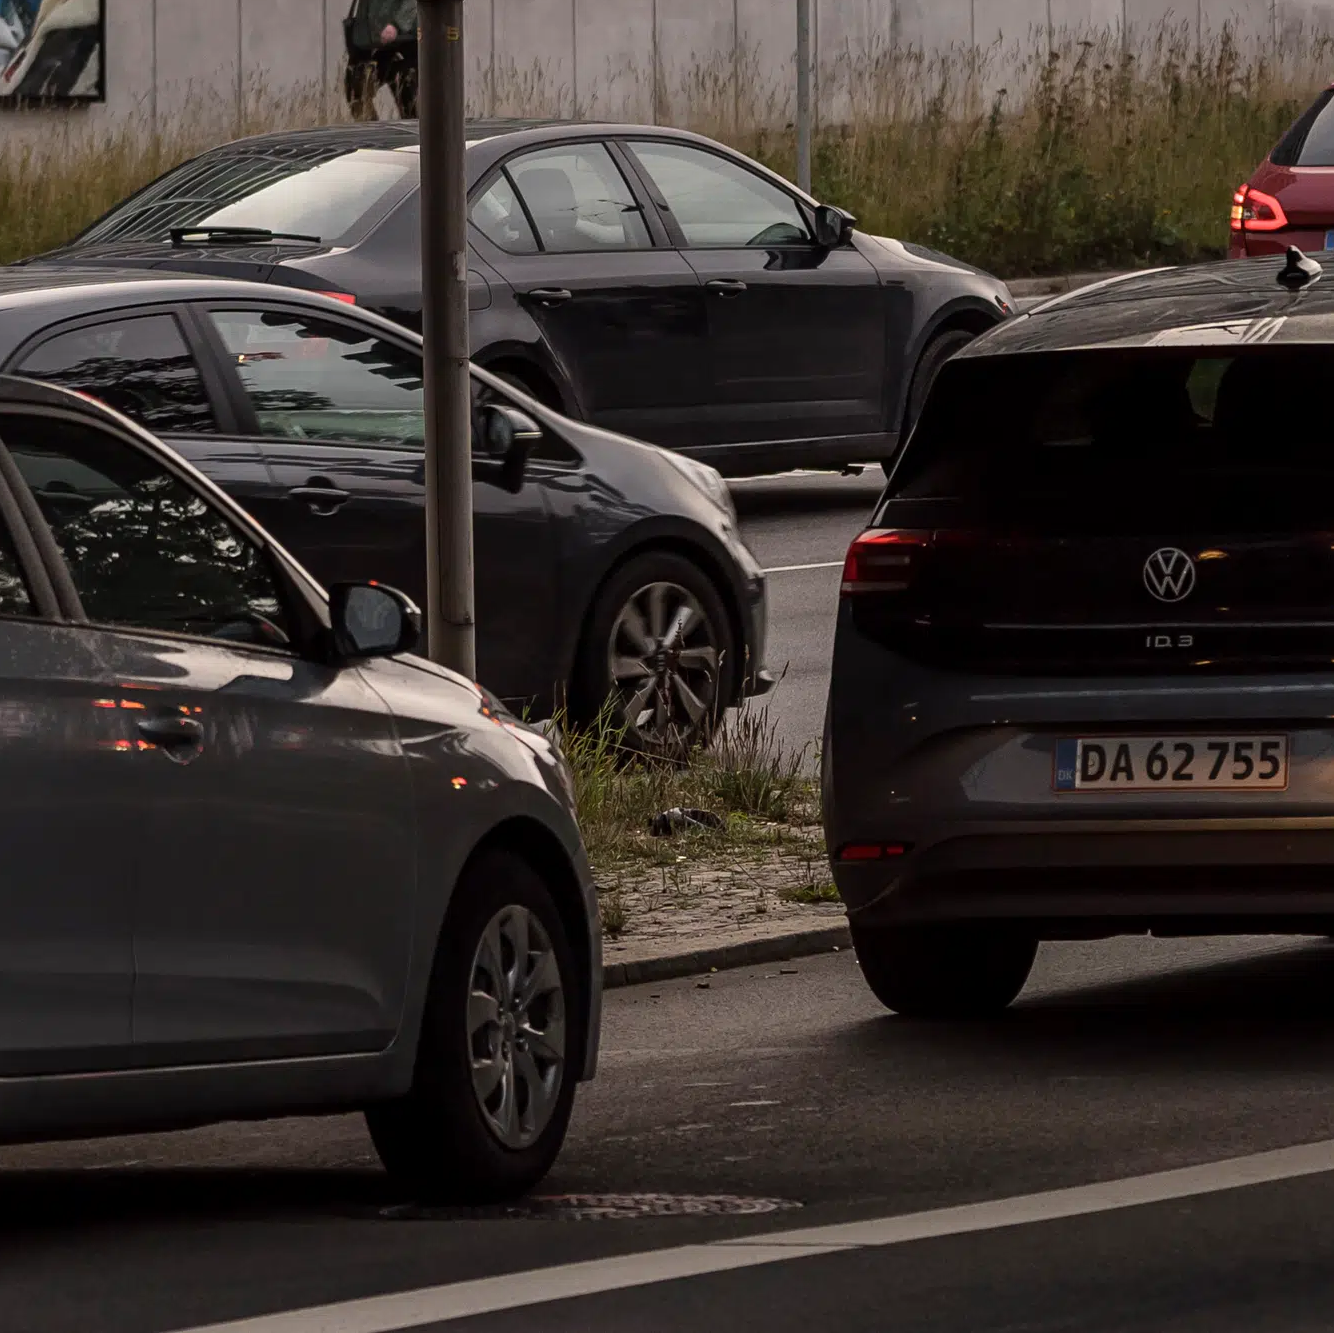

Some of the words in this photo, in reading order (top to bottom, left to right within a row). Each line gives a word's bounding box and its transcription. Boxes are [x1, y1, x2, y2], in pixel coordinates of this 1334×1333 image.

[1081, 743, 1134, 781] DA
[1146, 741, 1194, 781] 62
[1207, 741, 1281, 780] 755
